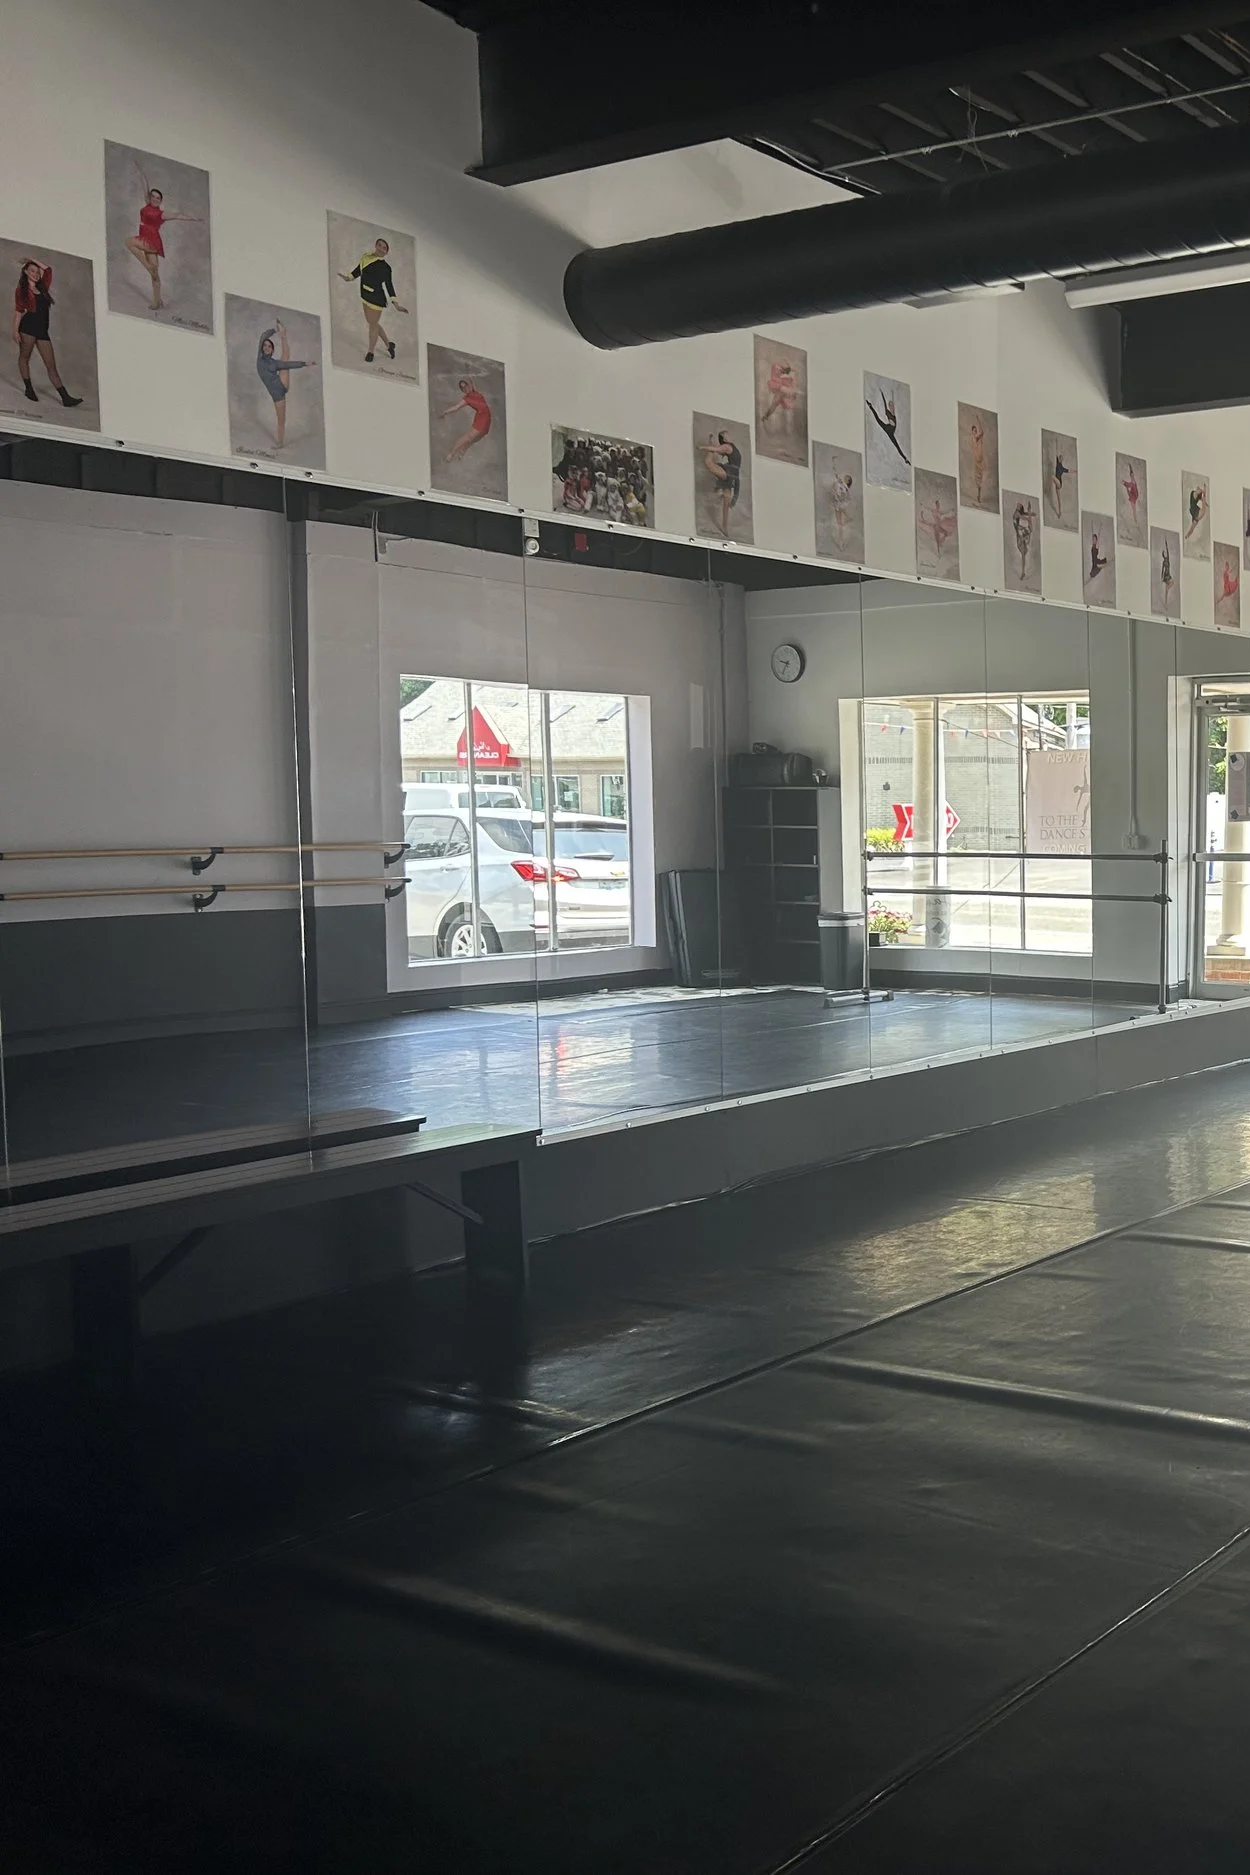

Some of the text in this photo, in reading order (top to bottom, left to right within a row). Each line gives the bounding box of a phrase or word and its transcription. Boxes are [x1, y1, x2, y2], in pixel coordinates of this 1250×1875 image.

[1047, 752, 1075, 765] NEW
[1039, 815, 1079, 827] TO THE
[1040, 829, 1079, 841] DANCE
